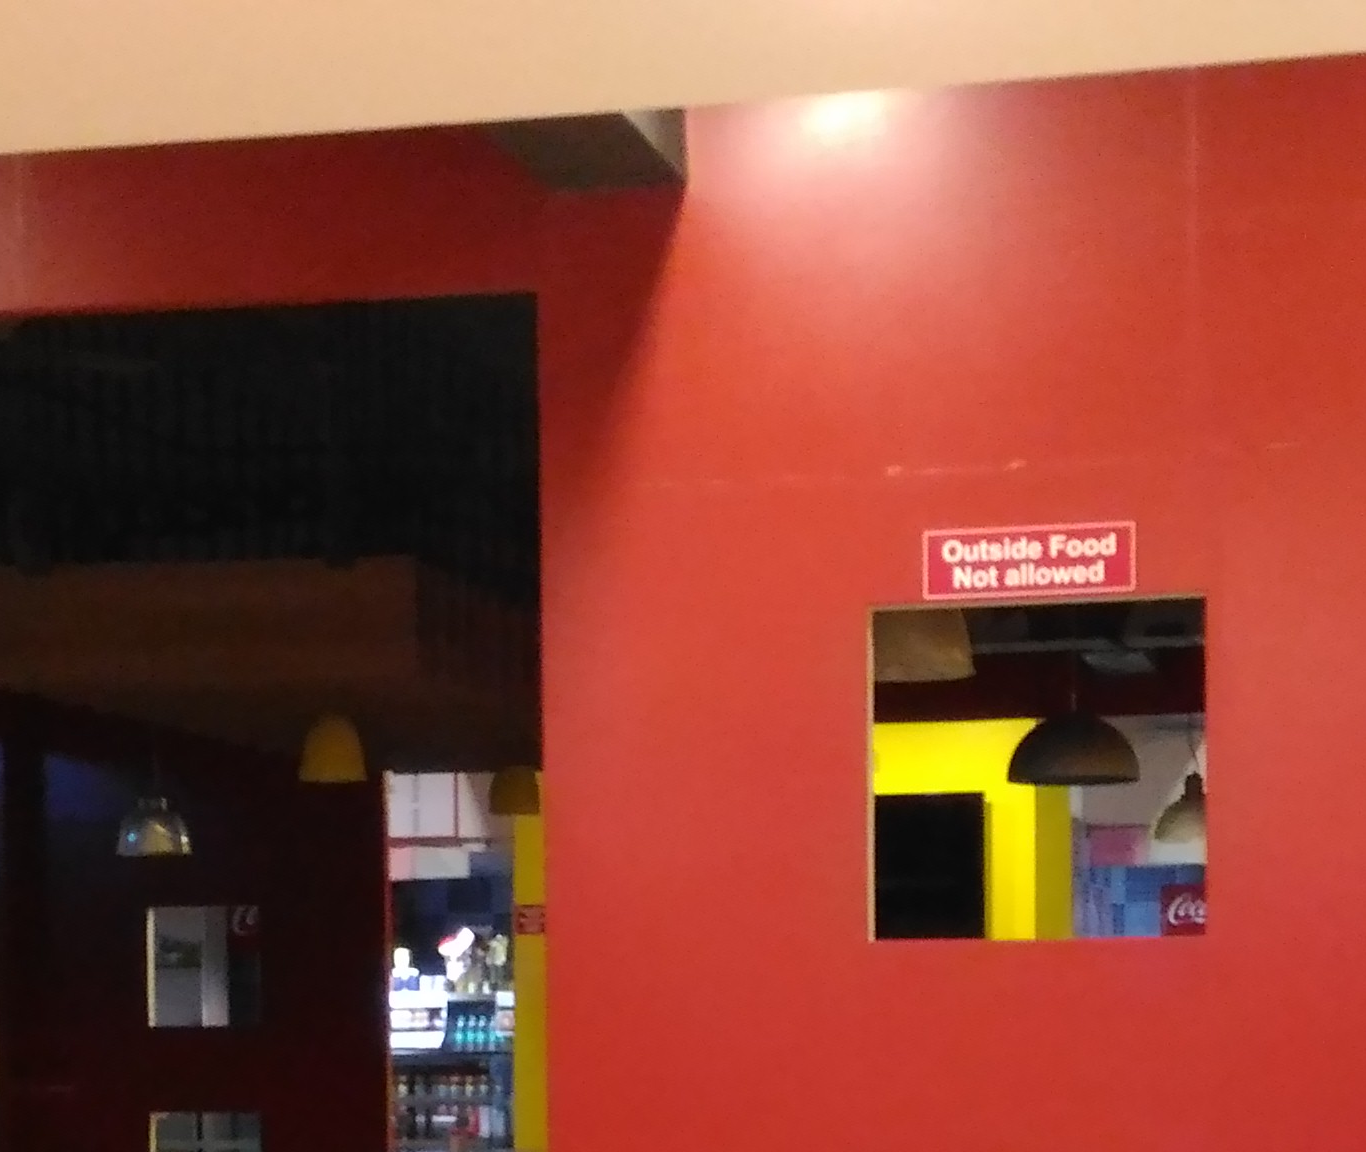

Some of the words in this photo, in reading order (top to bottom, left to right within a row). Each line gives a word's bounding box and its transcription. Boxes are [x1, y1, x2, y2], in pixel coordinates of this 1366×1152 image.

[941, 537, 1043, 563] Outside
[1048, 531, 1117, 559] Food
[952, 565, 999, 589] Not
[1004, 559, 1106, 586] allowed
